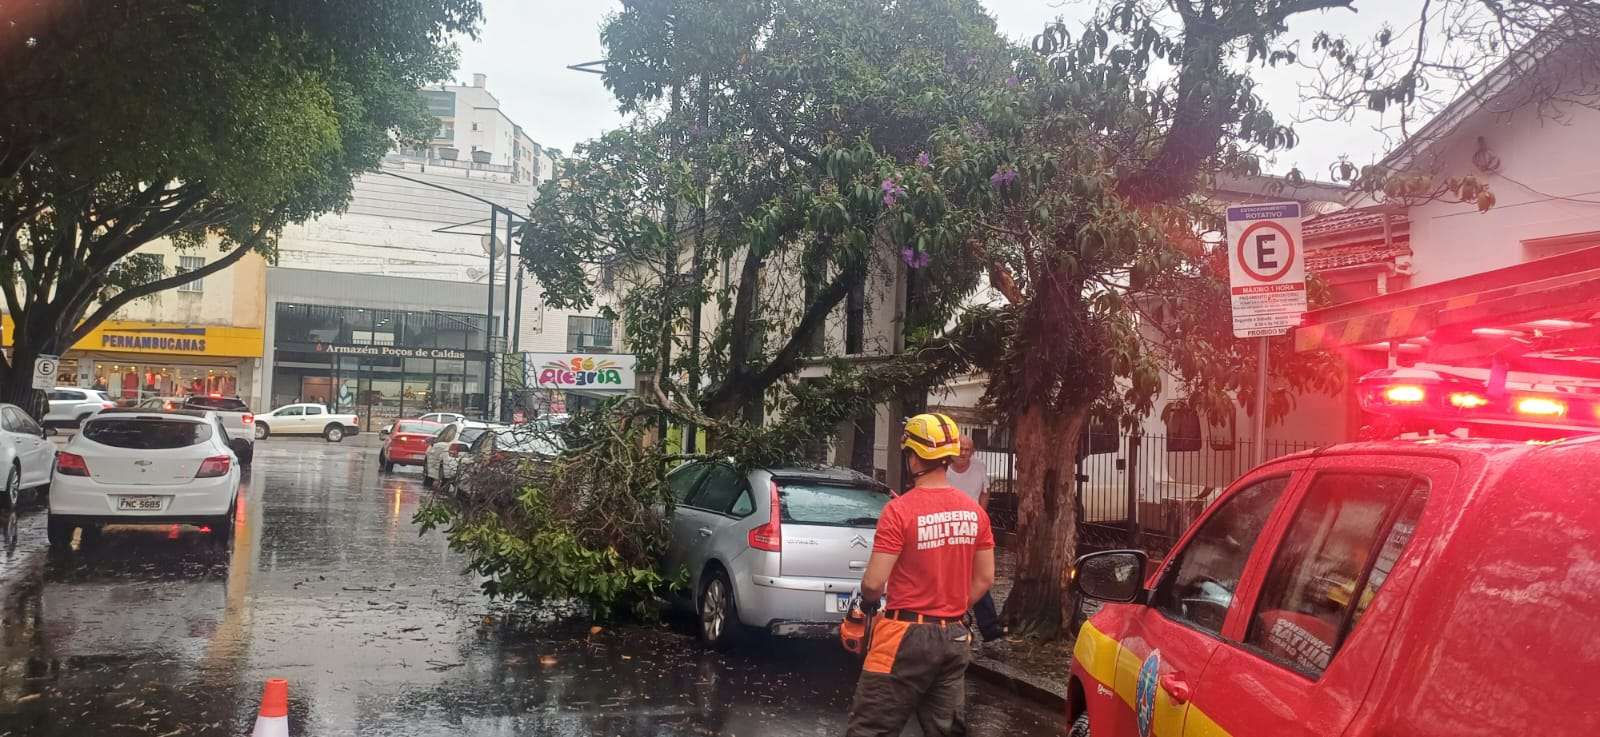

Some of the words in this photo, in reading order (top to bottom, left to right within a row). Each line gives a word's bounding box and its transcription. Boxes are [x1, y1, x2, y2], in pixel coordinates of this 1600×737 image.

[1245, 211, 1282, 219] ROTATIVO
[1256, 234, 1278, 270] E
[1276, 284, 1295, 292] HORA
[102, 334, 206, 352] PERNAMBUCANAS
[325, 344, 379, 355] Armazém
[382, 346, 413, 357] Poços
[415, 348, 429, 357] de
[430, 349, 465, 359] Caldas
[42, 362, 50, 372] E
[917, 510, 978, 527] BOMBEIRO
[917, 521, 978, 541] MILITAR
